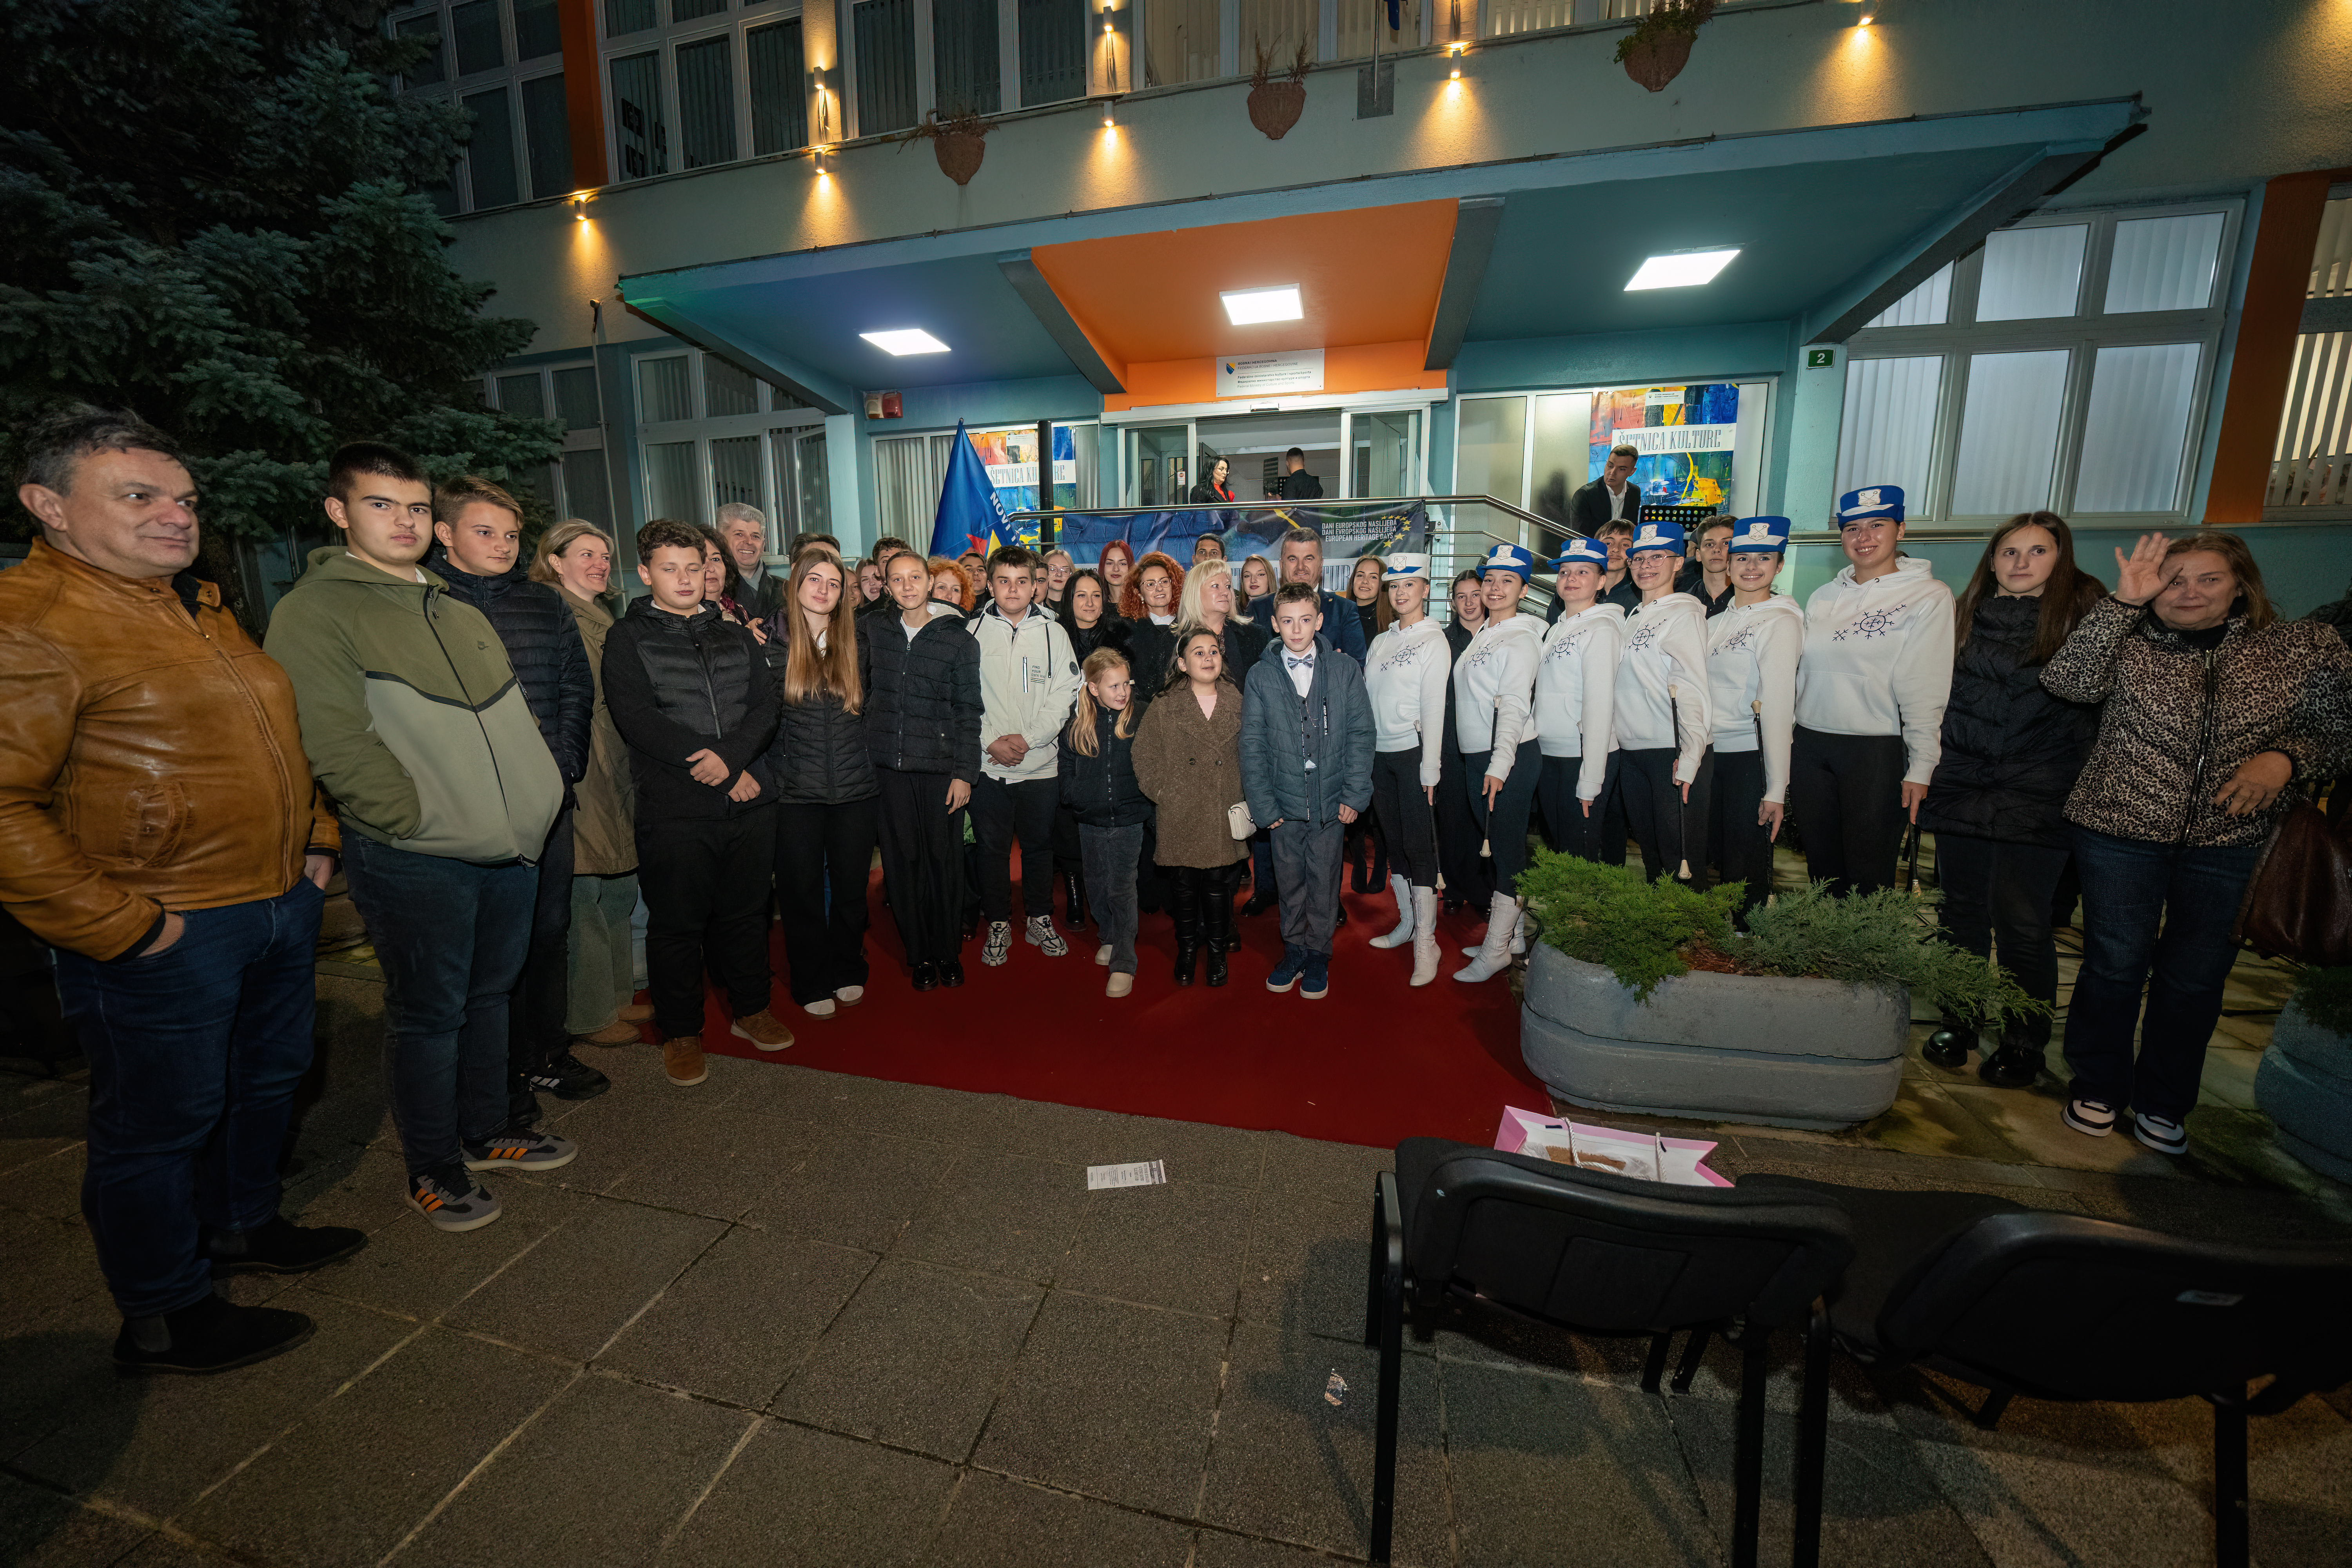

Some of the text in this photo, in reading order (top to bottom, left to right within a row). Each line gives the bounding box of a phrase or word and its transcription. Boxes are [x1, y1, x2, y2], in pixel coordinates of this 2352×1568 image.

[1817, 353, 1825, 363] 2
[1669, 430, 1721, 450] KULTURE
[991, 466, 1024, 484] ŠETNICA
[990, 491, 1011, 531] NOVI
